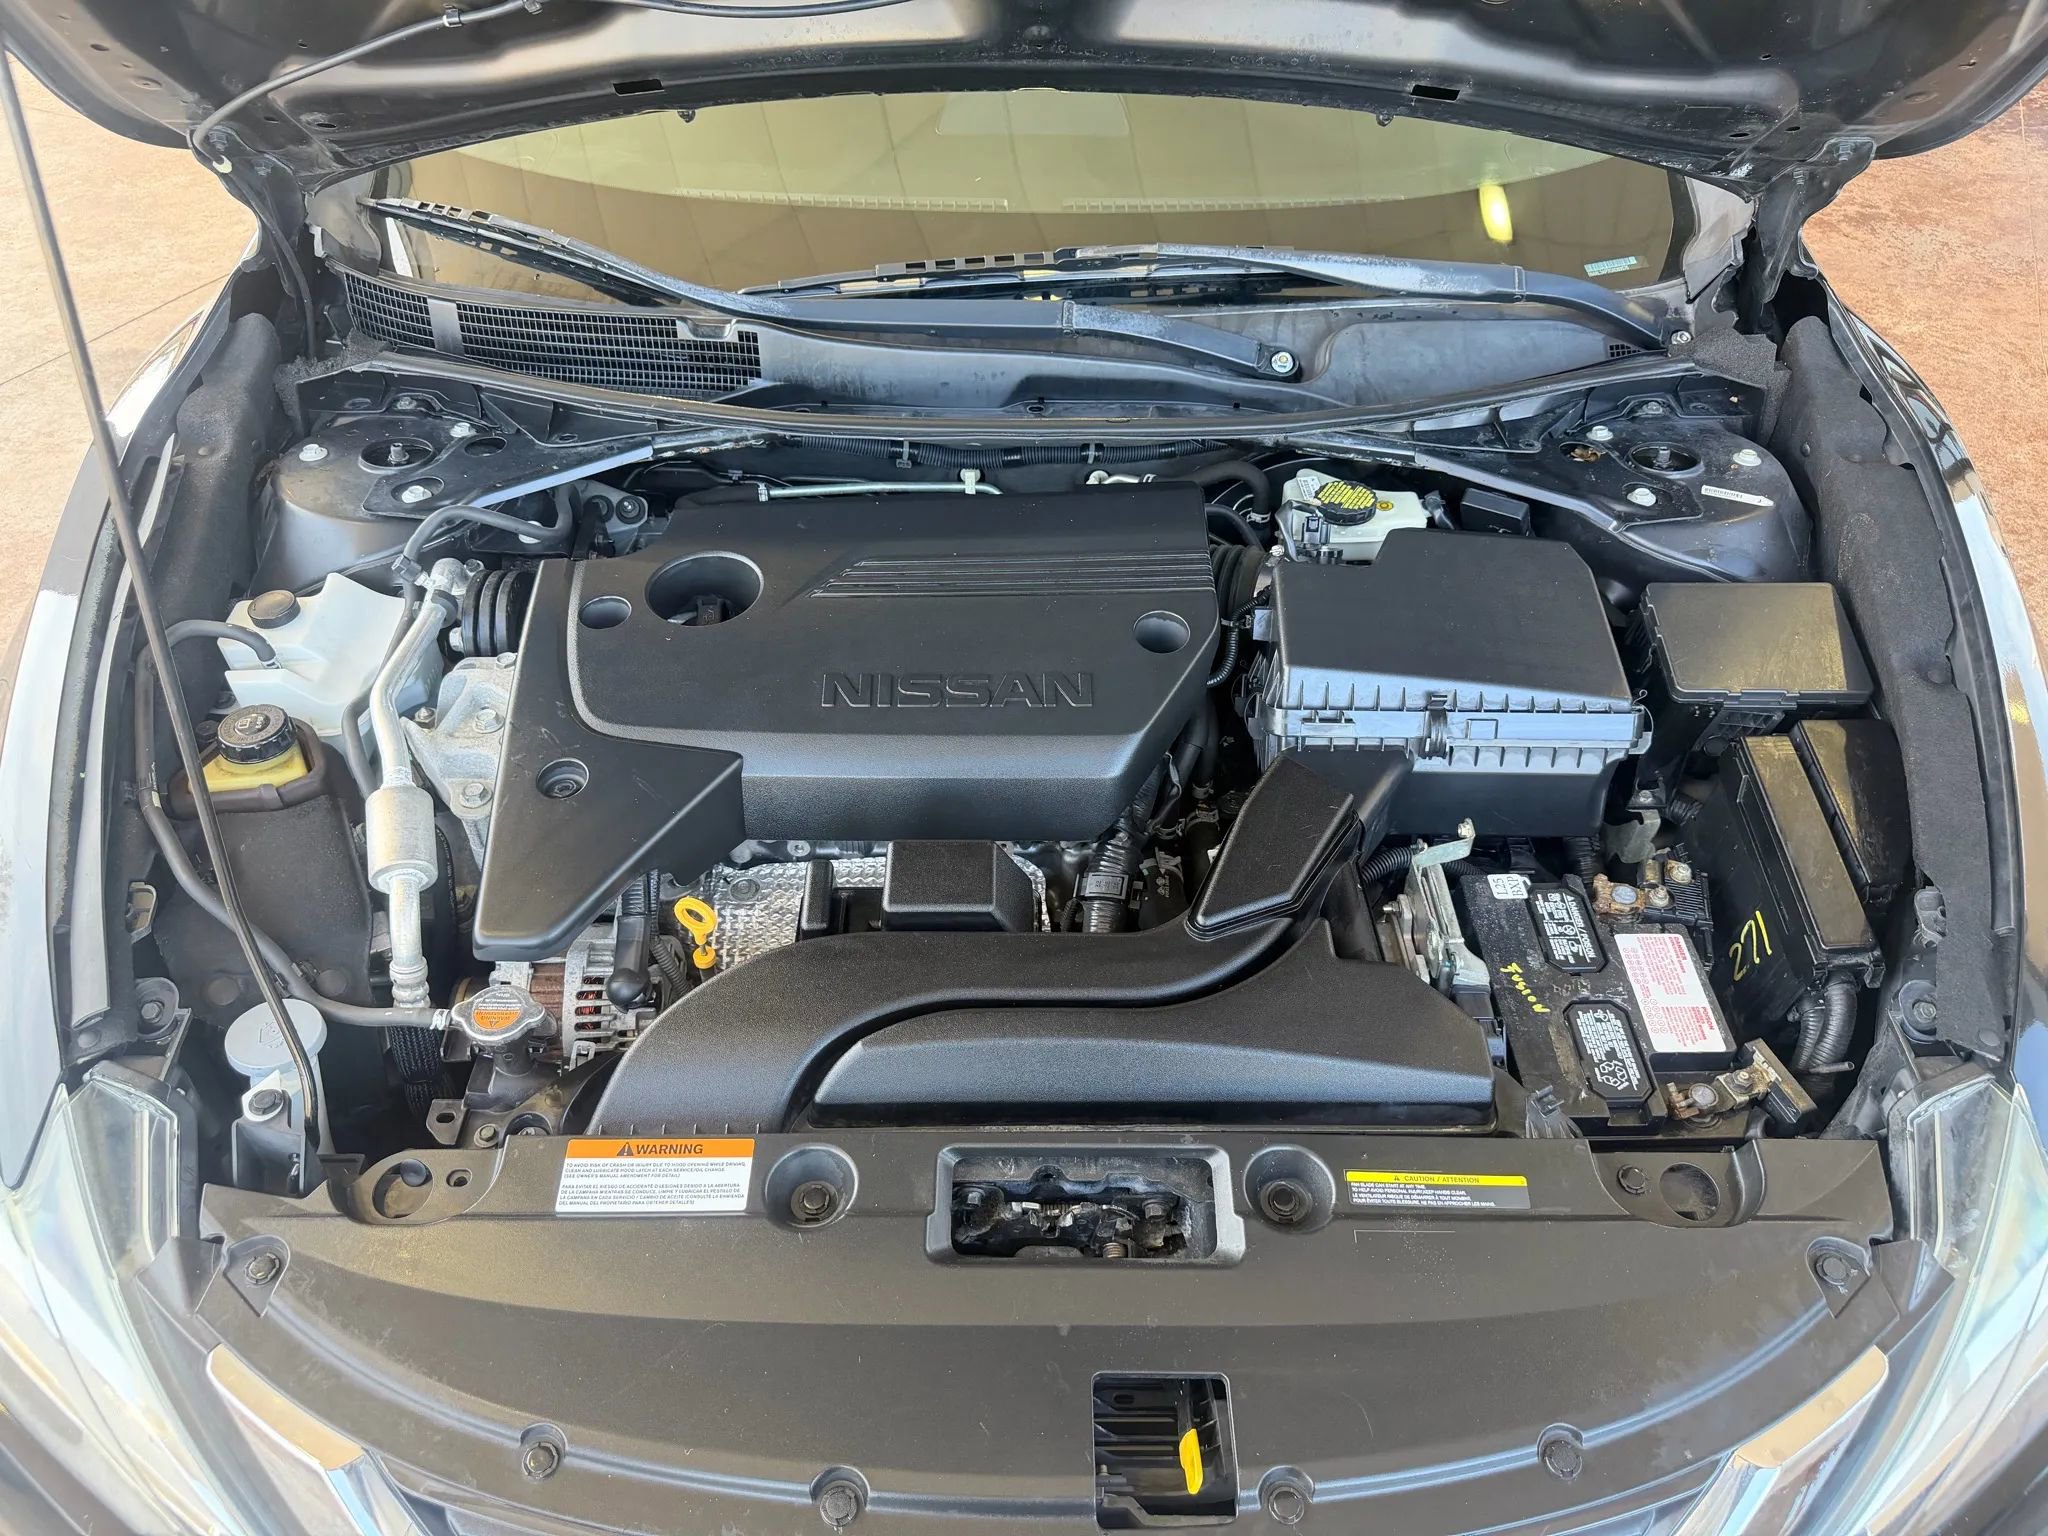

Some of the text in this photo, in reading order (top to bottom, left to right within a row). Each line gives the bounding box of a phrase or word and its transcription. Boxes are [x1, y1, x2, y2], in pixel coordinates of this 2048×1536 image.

[821, 672, 1093, 708] NISSAN
[1568, 902, 1585, 929] DANGER
[1580, 933, 1596, 958] POISON
[1674, 936, 1687, 960] DANGER
[1701, 1006, 1714, 1030] POISON
[636, 1144, 703, 1155] WARNING
